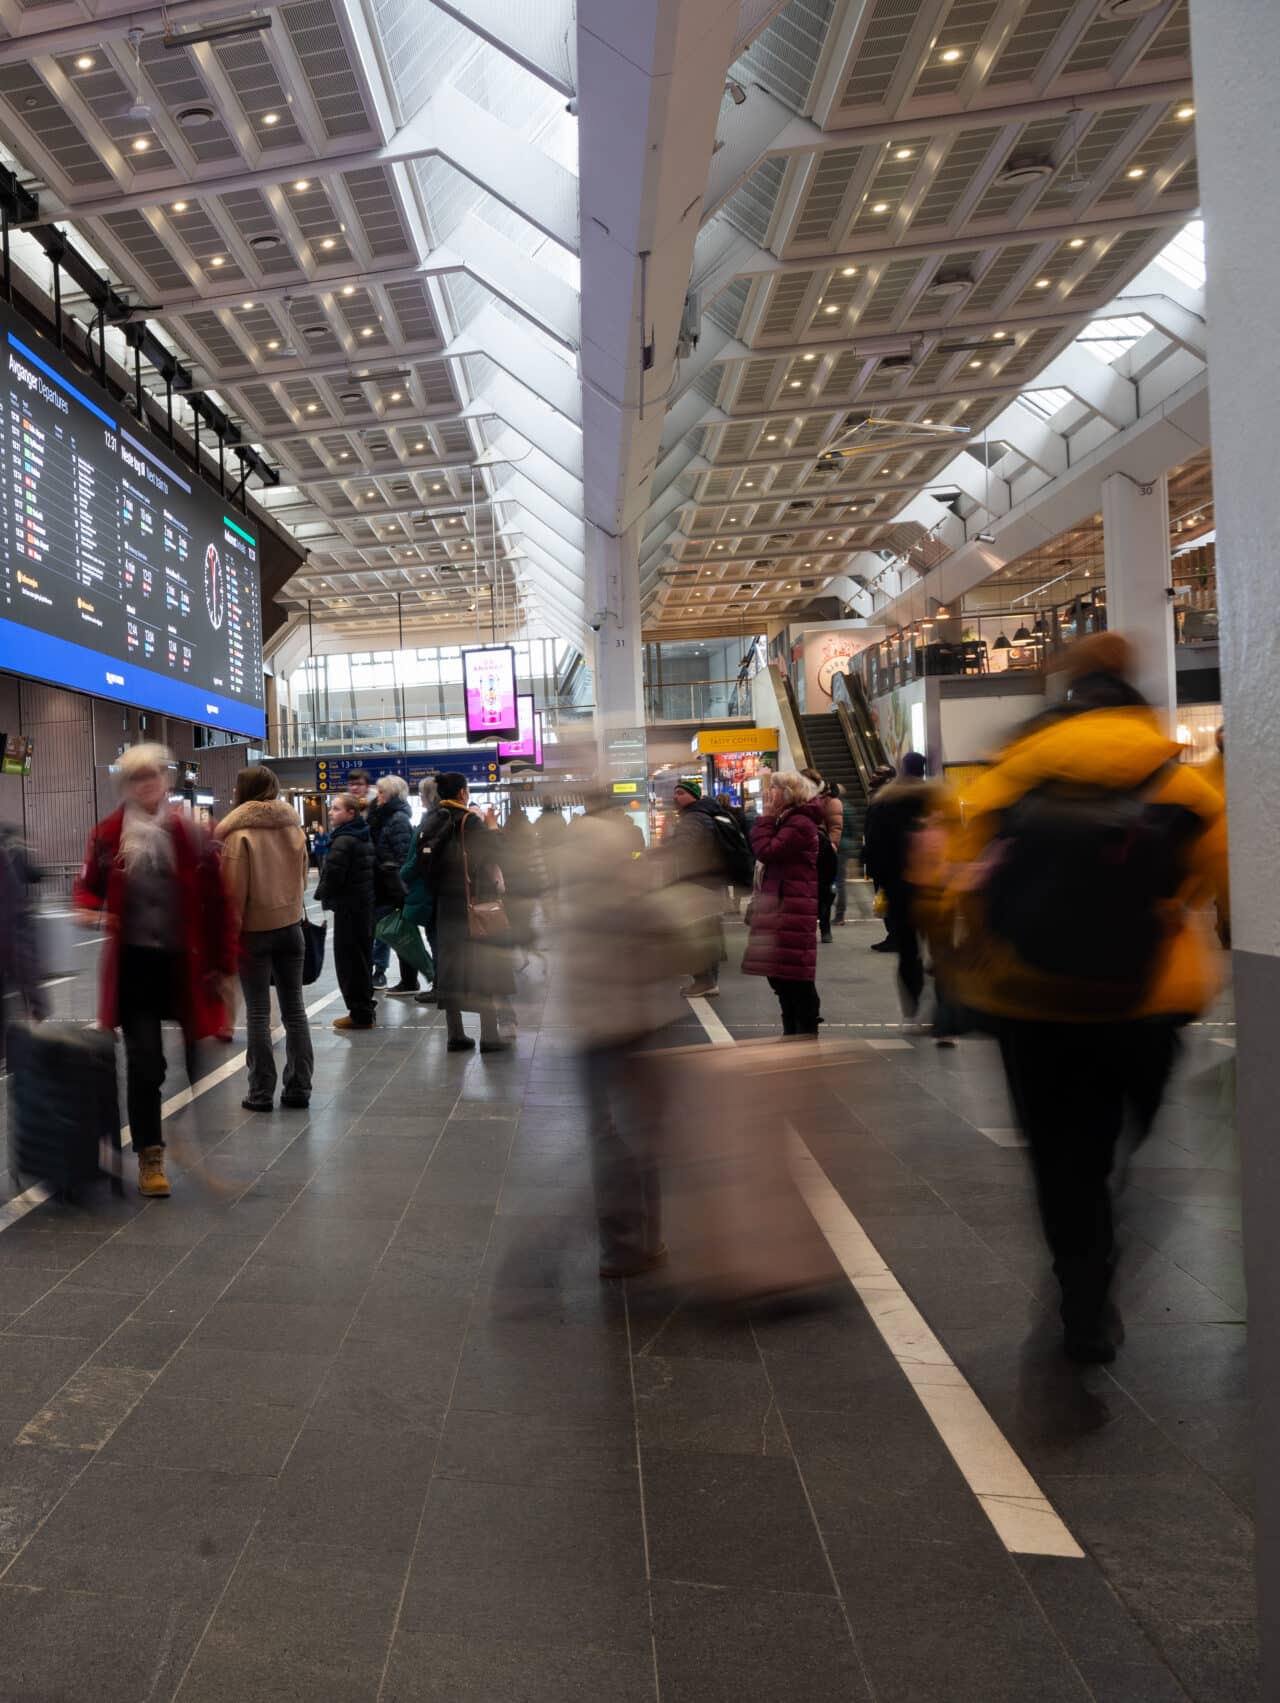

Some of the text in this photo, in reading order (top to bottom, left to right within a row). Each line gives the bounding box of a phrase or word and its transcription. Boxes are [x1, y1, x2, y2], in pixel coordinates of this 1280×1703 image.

[8, 353, 38, 390] Avganger
[38, 377, 69, 415] Departures
[1137, 486, 1152, 496] 30
